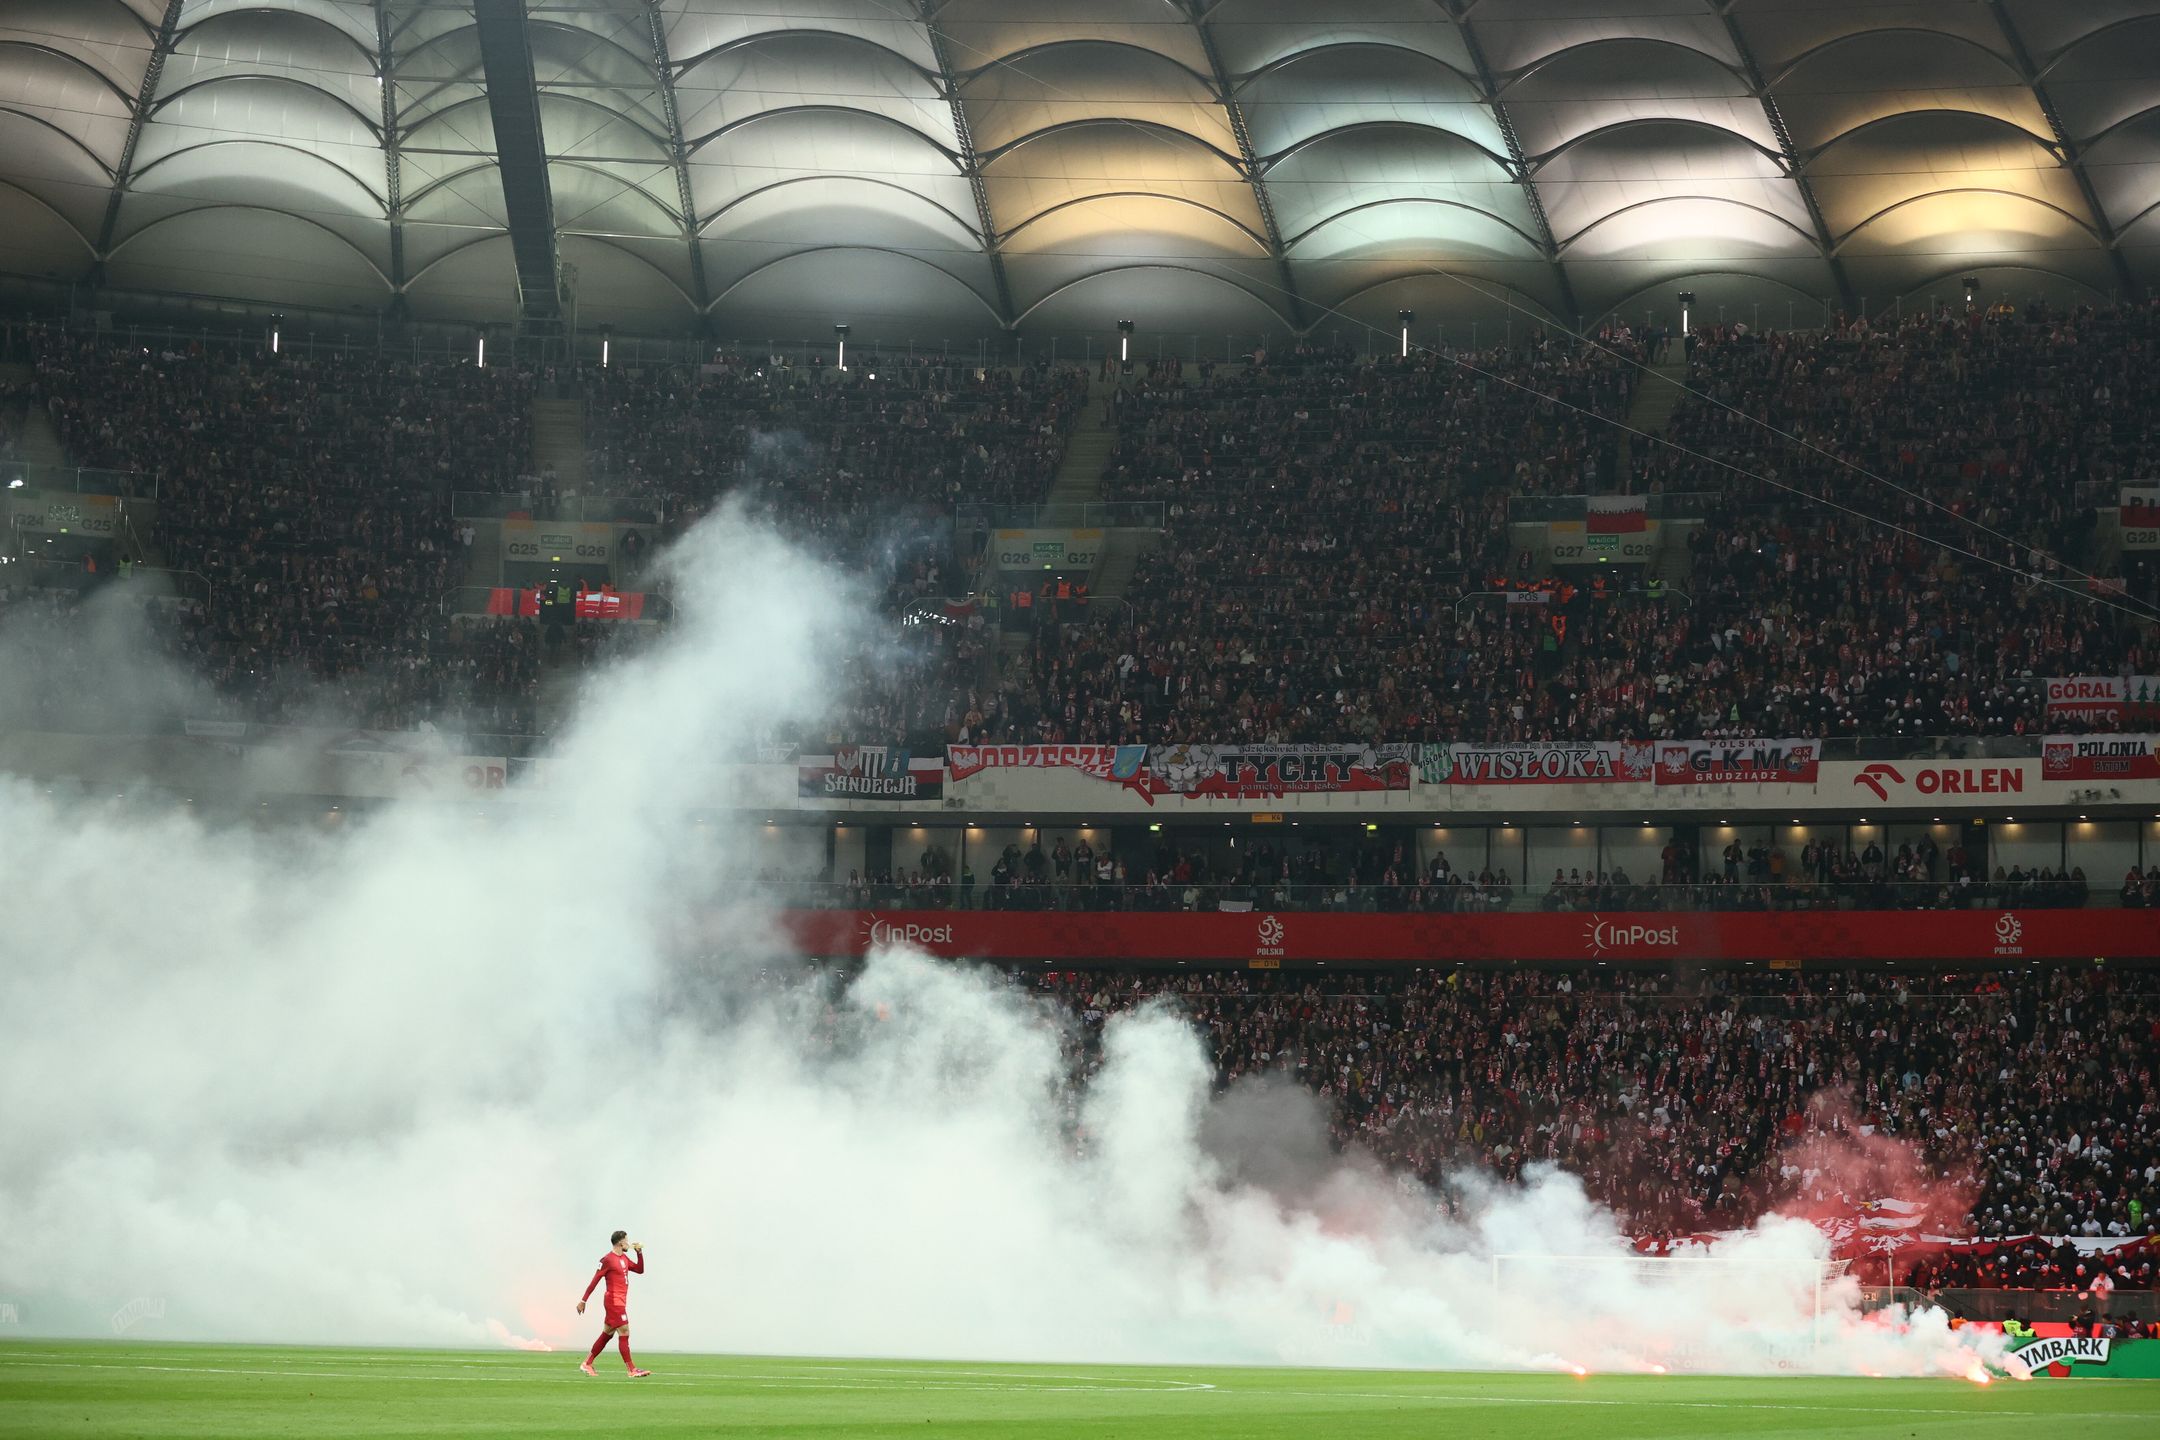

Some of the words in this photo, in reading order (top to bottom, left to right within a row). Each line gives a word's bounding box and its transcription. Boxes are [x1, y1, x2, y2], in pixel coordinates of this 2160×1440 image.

[81, 519, 111, 531] G25
[2126, 531, 2157, 544] G28
[509, 543, 538, 556] G25
[576, 545, 606, 557] G26
[1554, 546, 1584, 557] G27
[1622, 544, 1653, 556] G28
[1001, 552, 1031, 564] G26
[1068, 552, 1097, 564] G27
[2049, 679, 2117, 699] GÓRAL
[1710, 740, 1766, 748] POLSKA
[2078, 742, 2147, 757] POLONIA
[1456, 751, 1615, 779] WISŁOKA
[1690, 748, 1781, 772] GKM
[1220, 754, 1360, 783] TYCHY
[1696, 772, 1777, 782] GRUDZIĄDZ
[1915, 768, 2023, 794] ORLEN
[825, 773, 916, 796] SANDECJA
[886, 924, 952, 943] InPost
[1610, 925, 1678, 945] InPost
[1257, 948, 1284, 956] POLSKA
[1995, 947, 2022, 955] POLSKA
[2018, 1339, 2104, 1368] YMBARK
